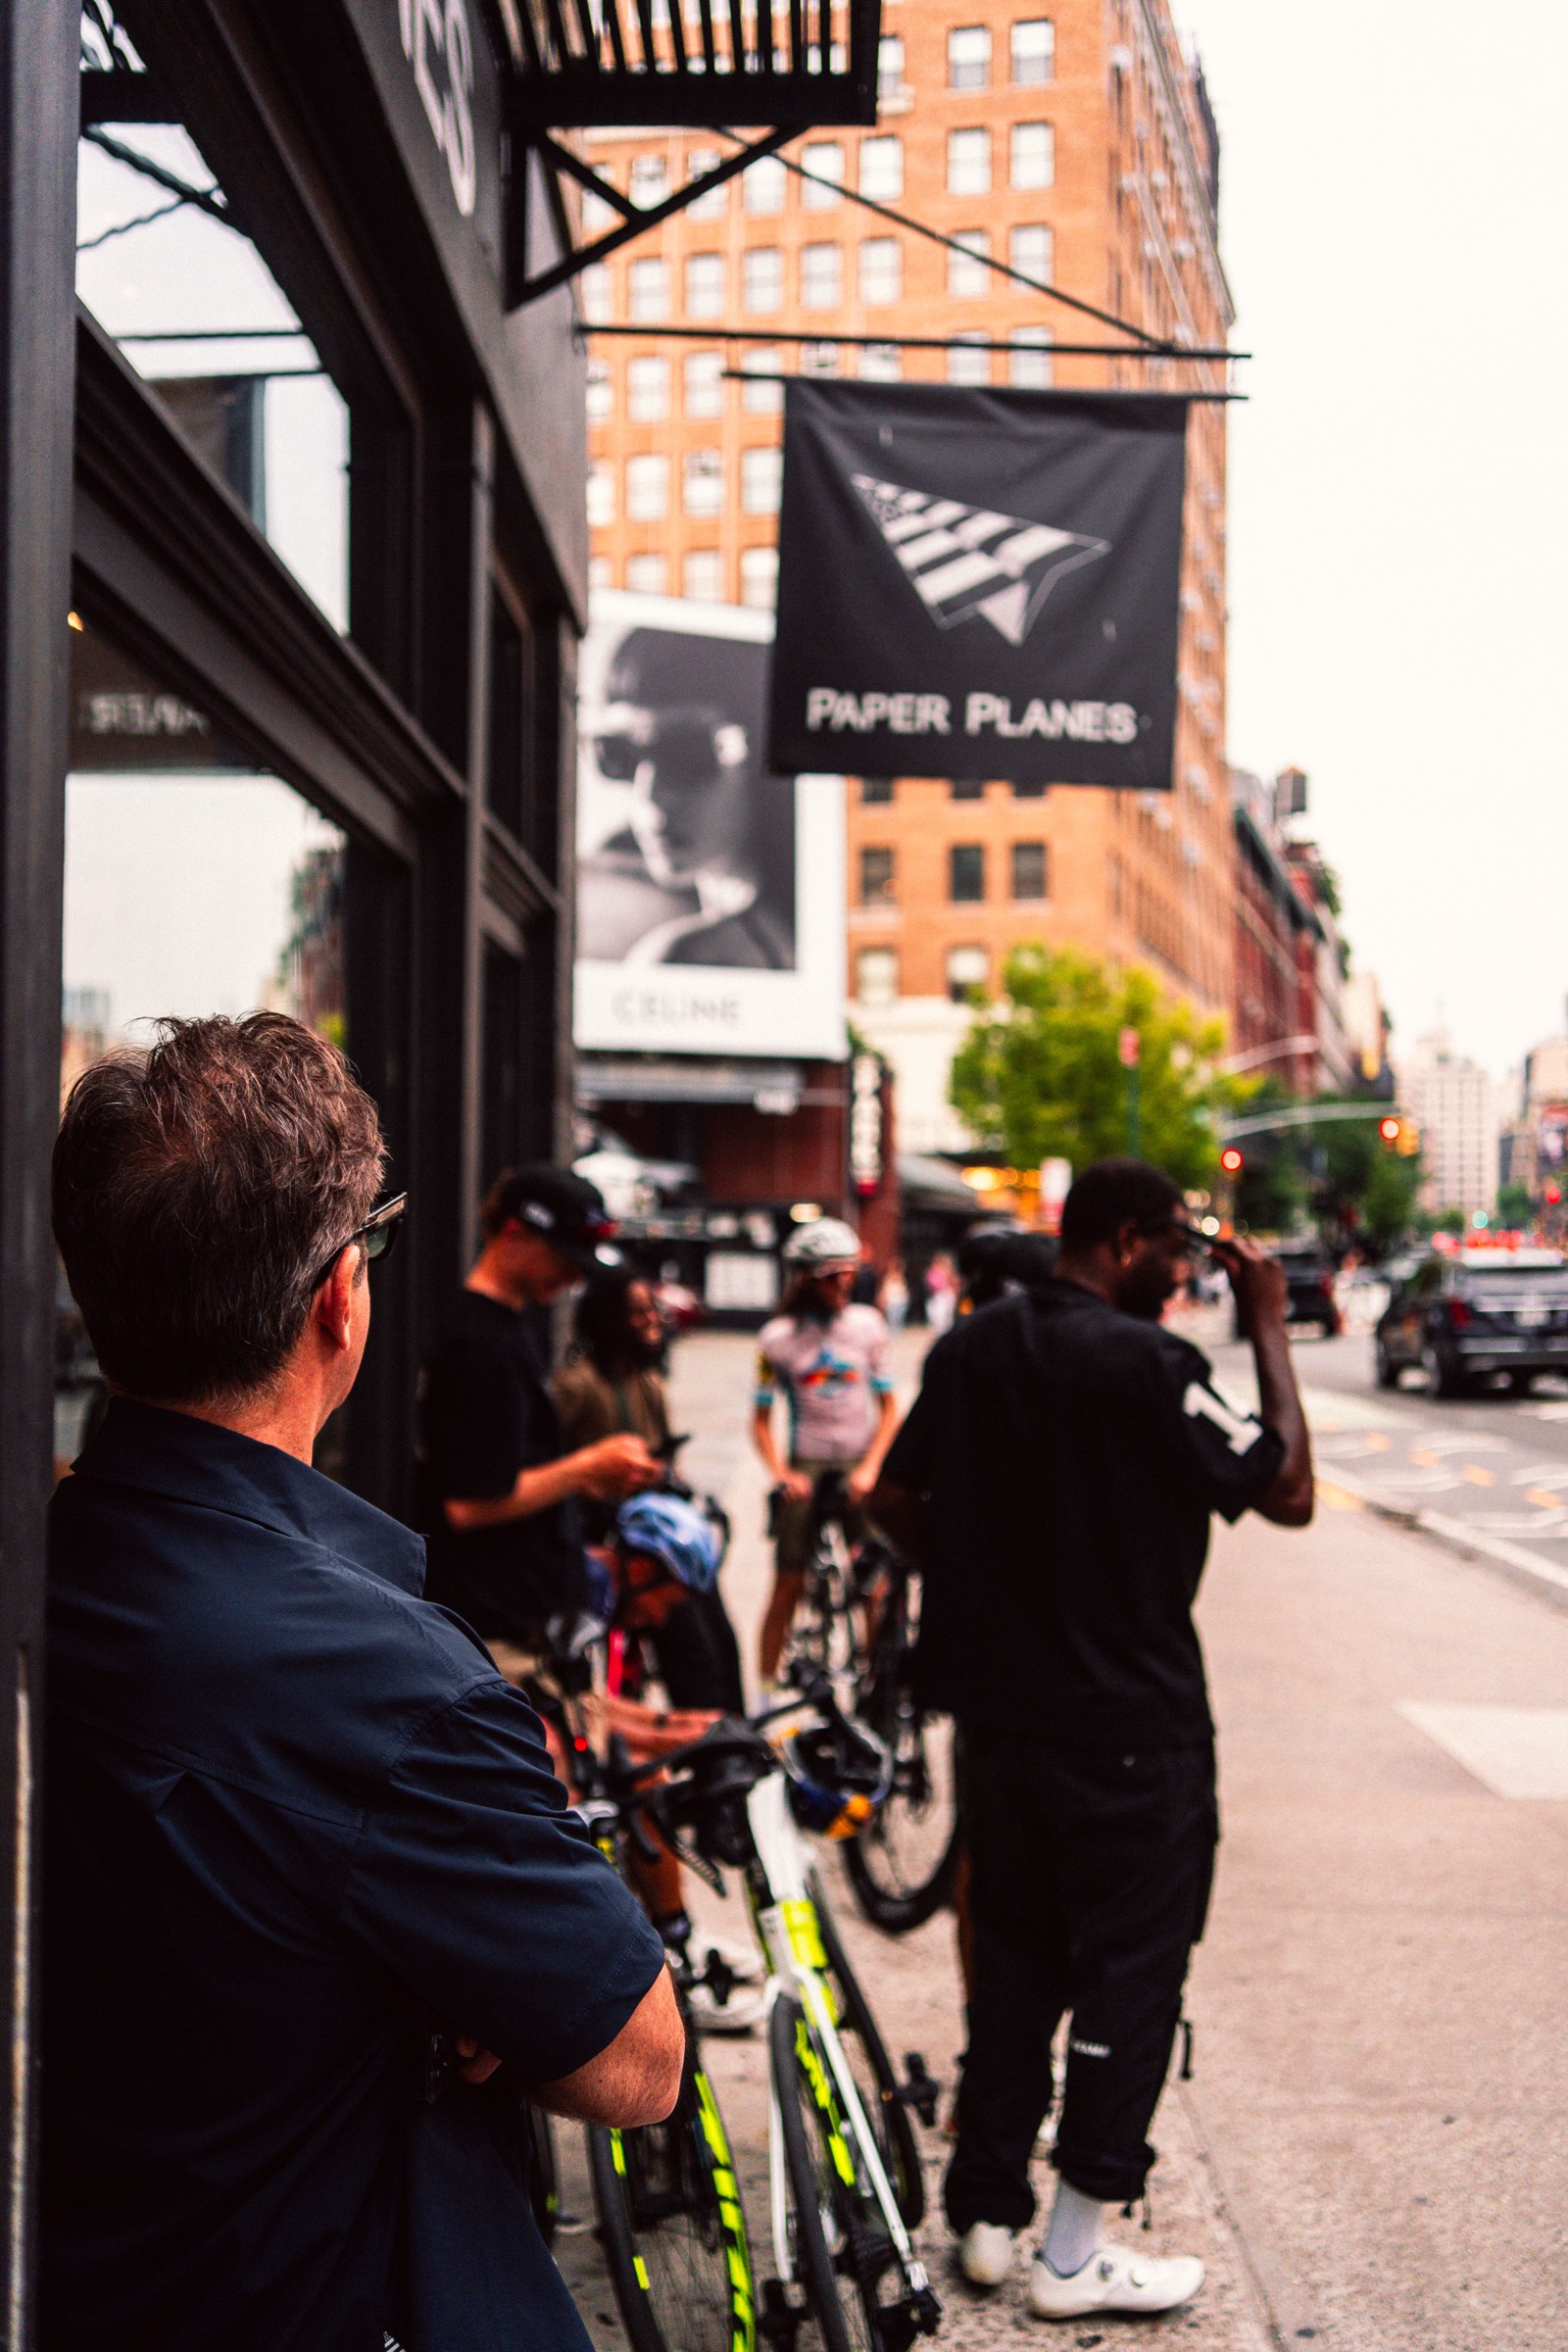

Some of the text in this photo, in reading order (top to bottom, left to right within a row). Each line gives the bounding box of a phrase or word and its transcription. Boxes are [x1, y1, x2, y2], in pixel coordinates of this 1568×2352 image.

[807, 687, 1138, 744] PAPER PLANES
[611, 986, 741, 1028] CELINE
